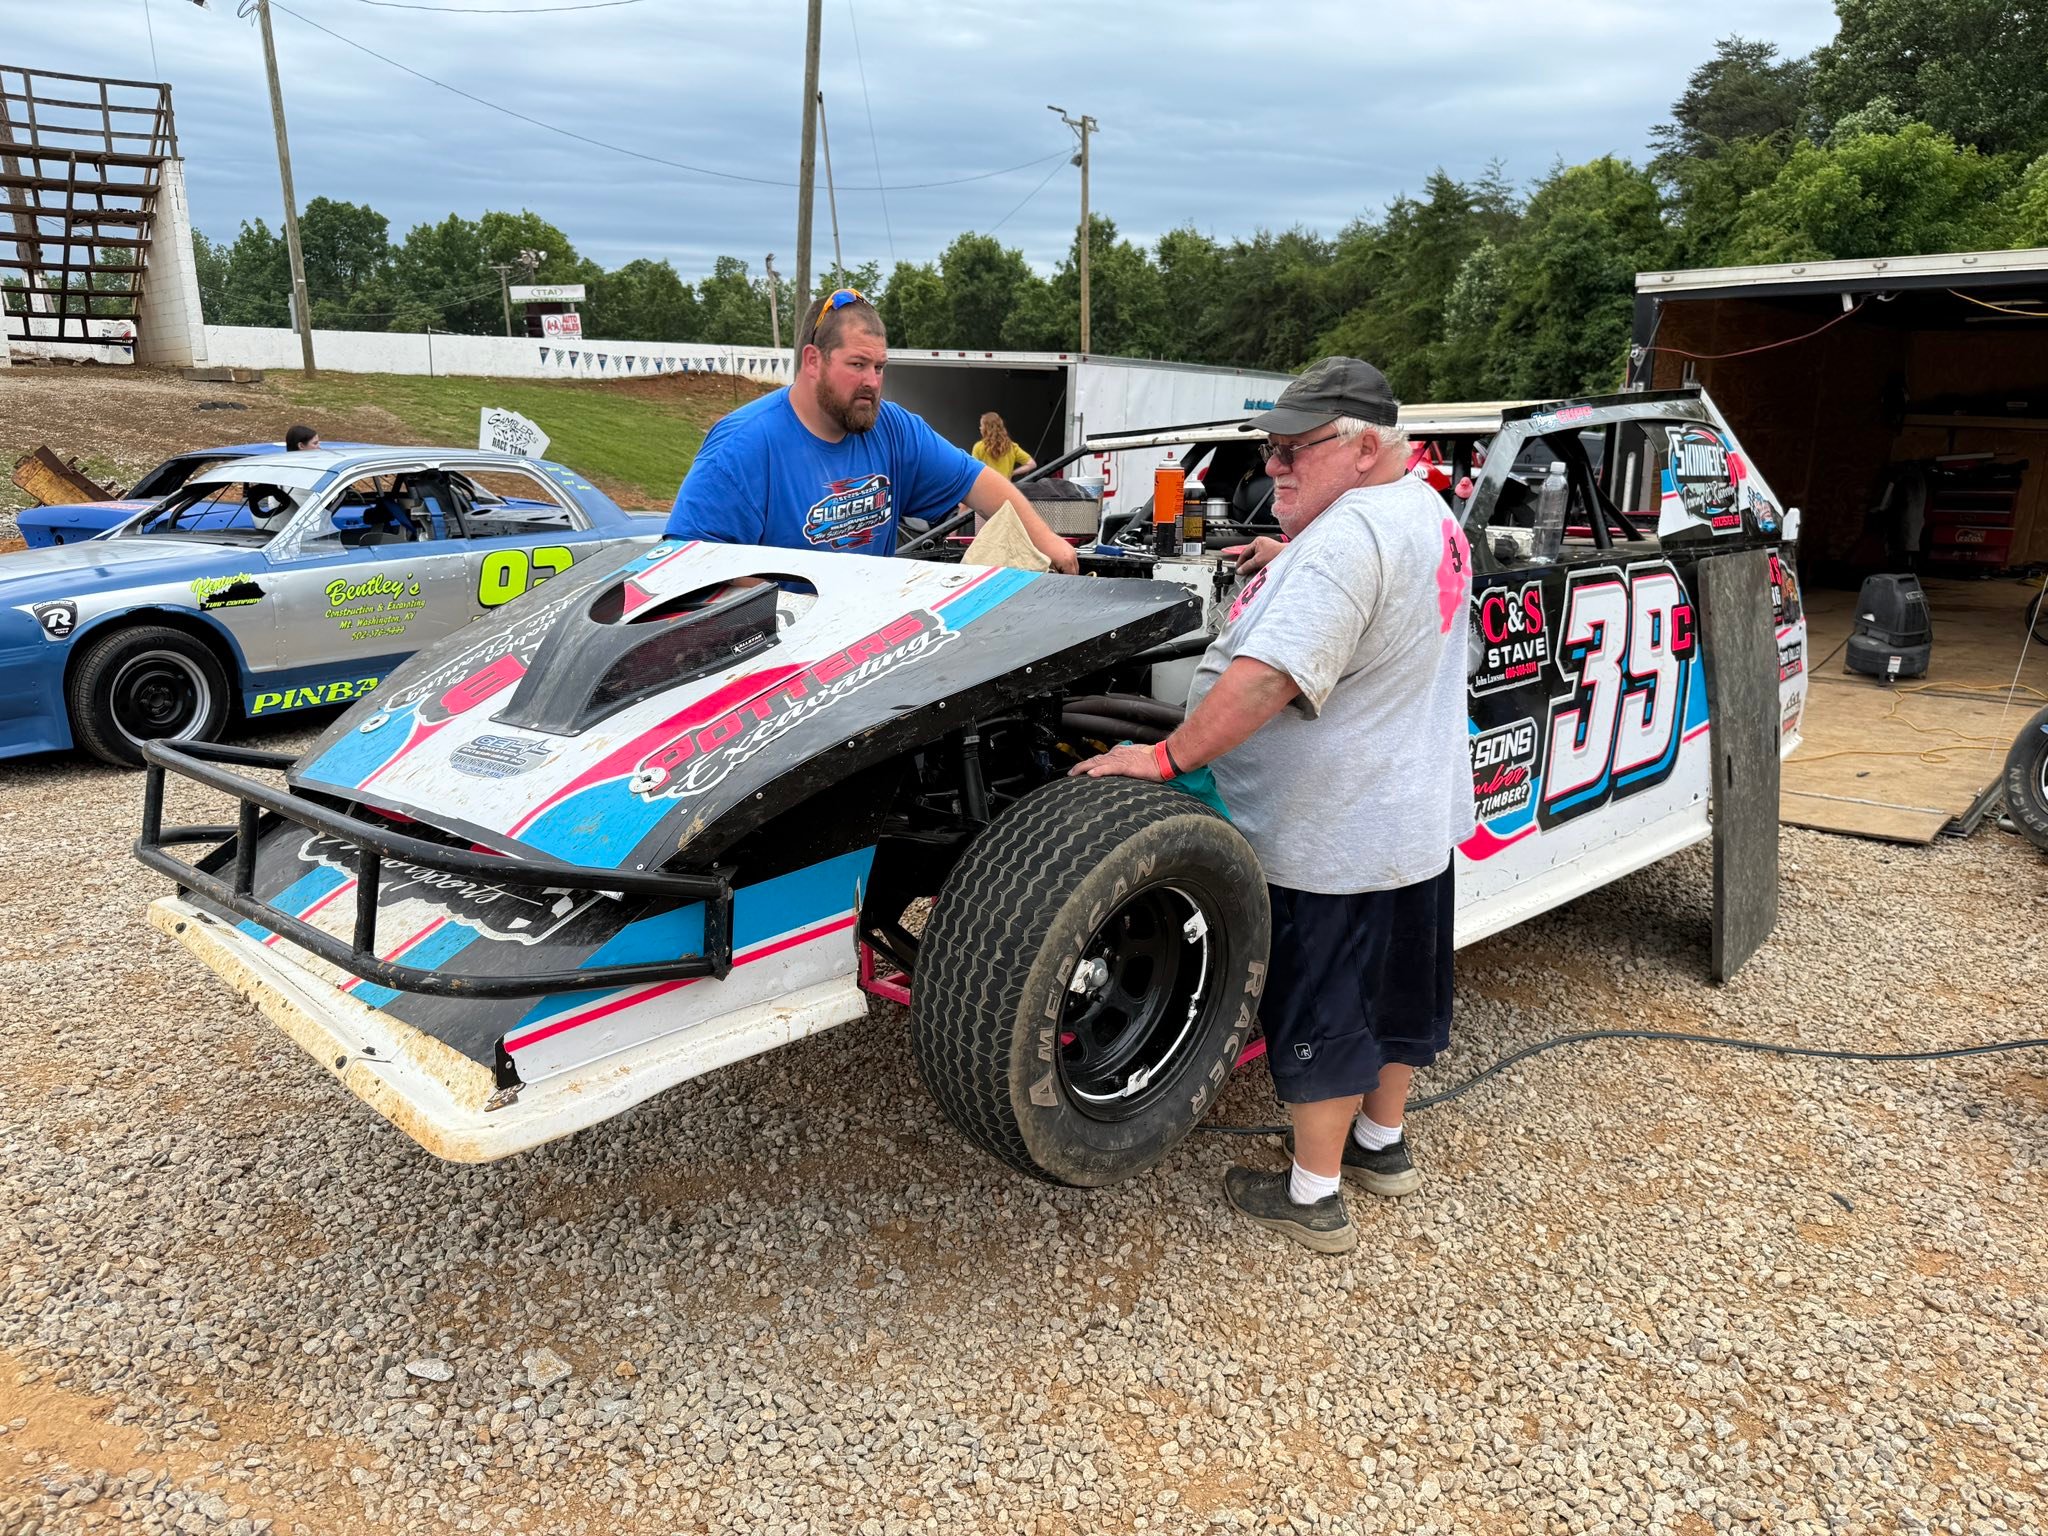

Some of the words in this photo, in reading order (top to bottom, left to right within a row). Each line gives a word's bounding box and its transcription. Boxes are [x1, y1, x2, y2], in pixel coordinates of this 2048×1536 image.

[561, 323, 579, 332] SALES
[562, 315, 577, 323] AUTO
[492, 437, 507, 452] RACE
[509, 444, 527, 457] TEAM
[191, 572, 251, 604] Kentucky
[226, 598, 262, 606] COMPANY
[325, 573, 421, 607] Bentley's
[41, 608, 73, 628] R
[325, 604, 375, 619] Construction
[377, 602, 384, 612] &
[404, 611, 417, 620] KY
[1482, 590, 1543, 644] C&S
[1488, 637, 1546, 669] STAVE
[405, 634, 515, 704] Cleaning
[1475, 675, 1488, 687] John
[1487, 673, 1505, 684] Lawson
[643, 614, 926, 792] POTTERS
[679, 630, 941, 791] Excavating
[1474, 725, 1533, 770] SONS
[1482, 784, 1528, 814] TIMBER?
[1190, 959, 1267, 1117] RACER
